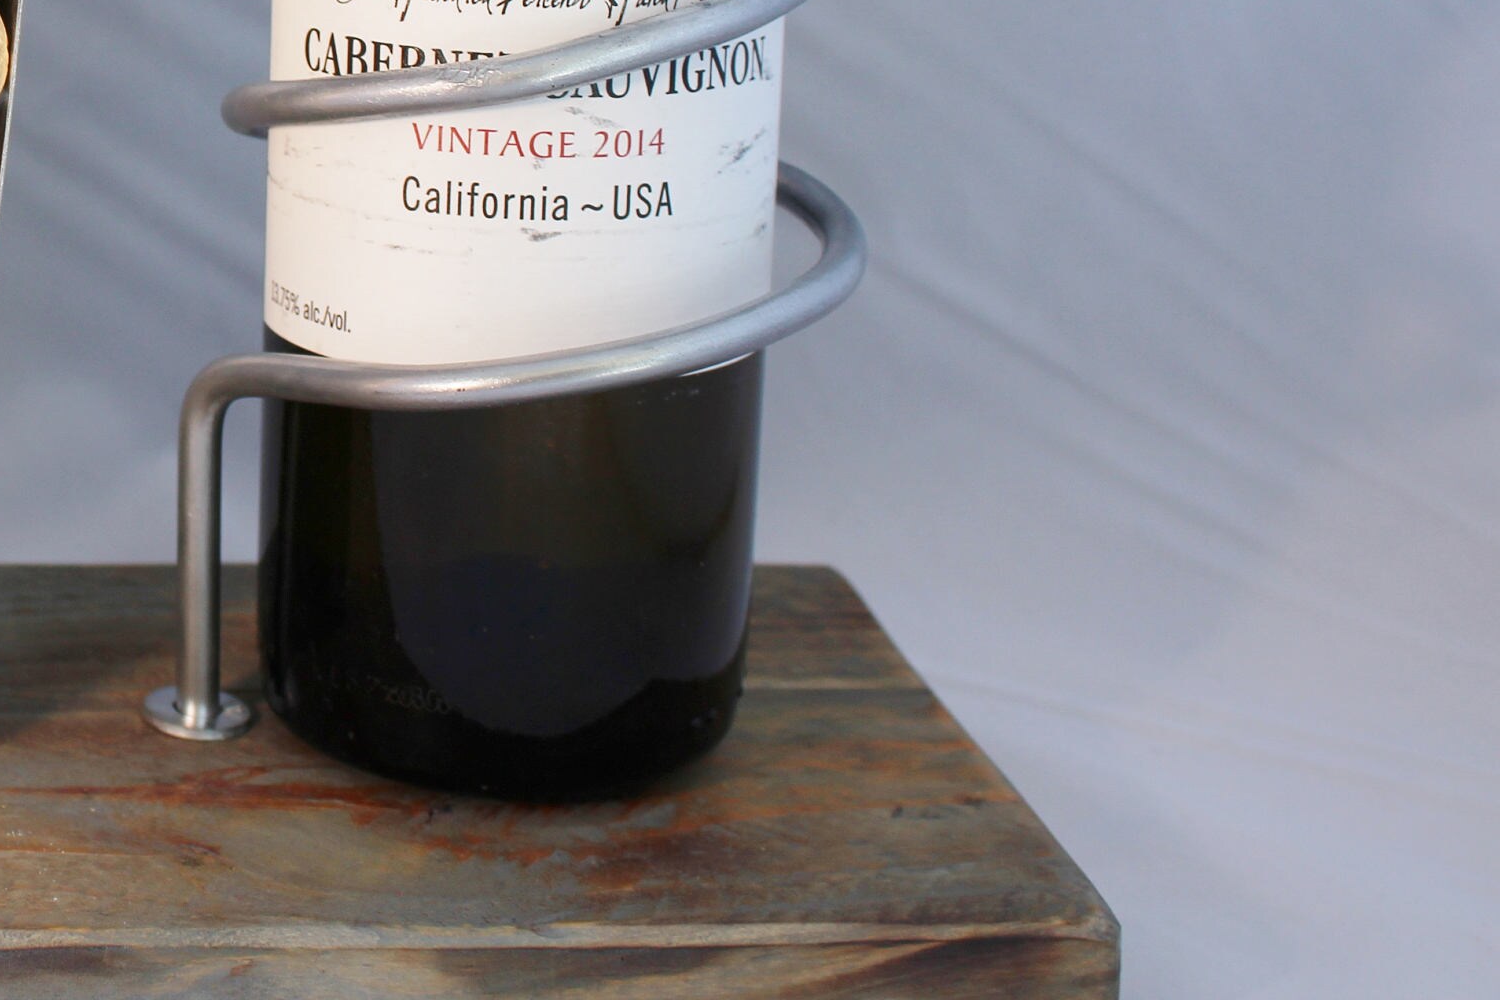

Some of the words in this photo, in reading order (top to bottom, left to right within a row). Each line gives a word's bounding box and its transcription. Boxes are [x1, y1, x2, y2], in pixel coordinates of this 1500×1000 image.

[547, 36, 767, 99] UVIGNON
[412, 122, 577, 158] VINTAGE
[594, 128, 666, 158] 2014
[402, 176, 569, 221] California
[613, 182, 673, 219] USA
[303, 301, 351, 333] alc./vol.
